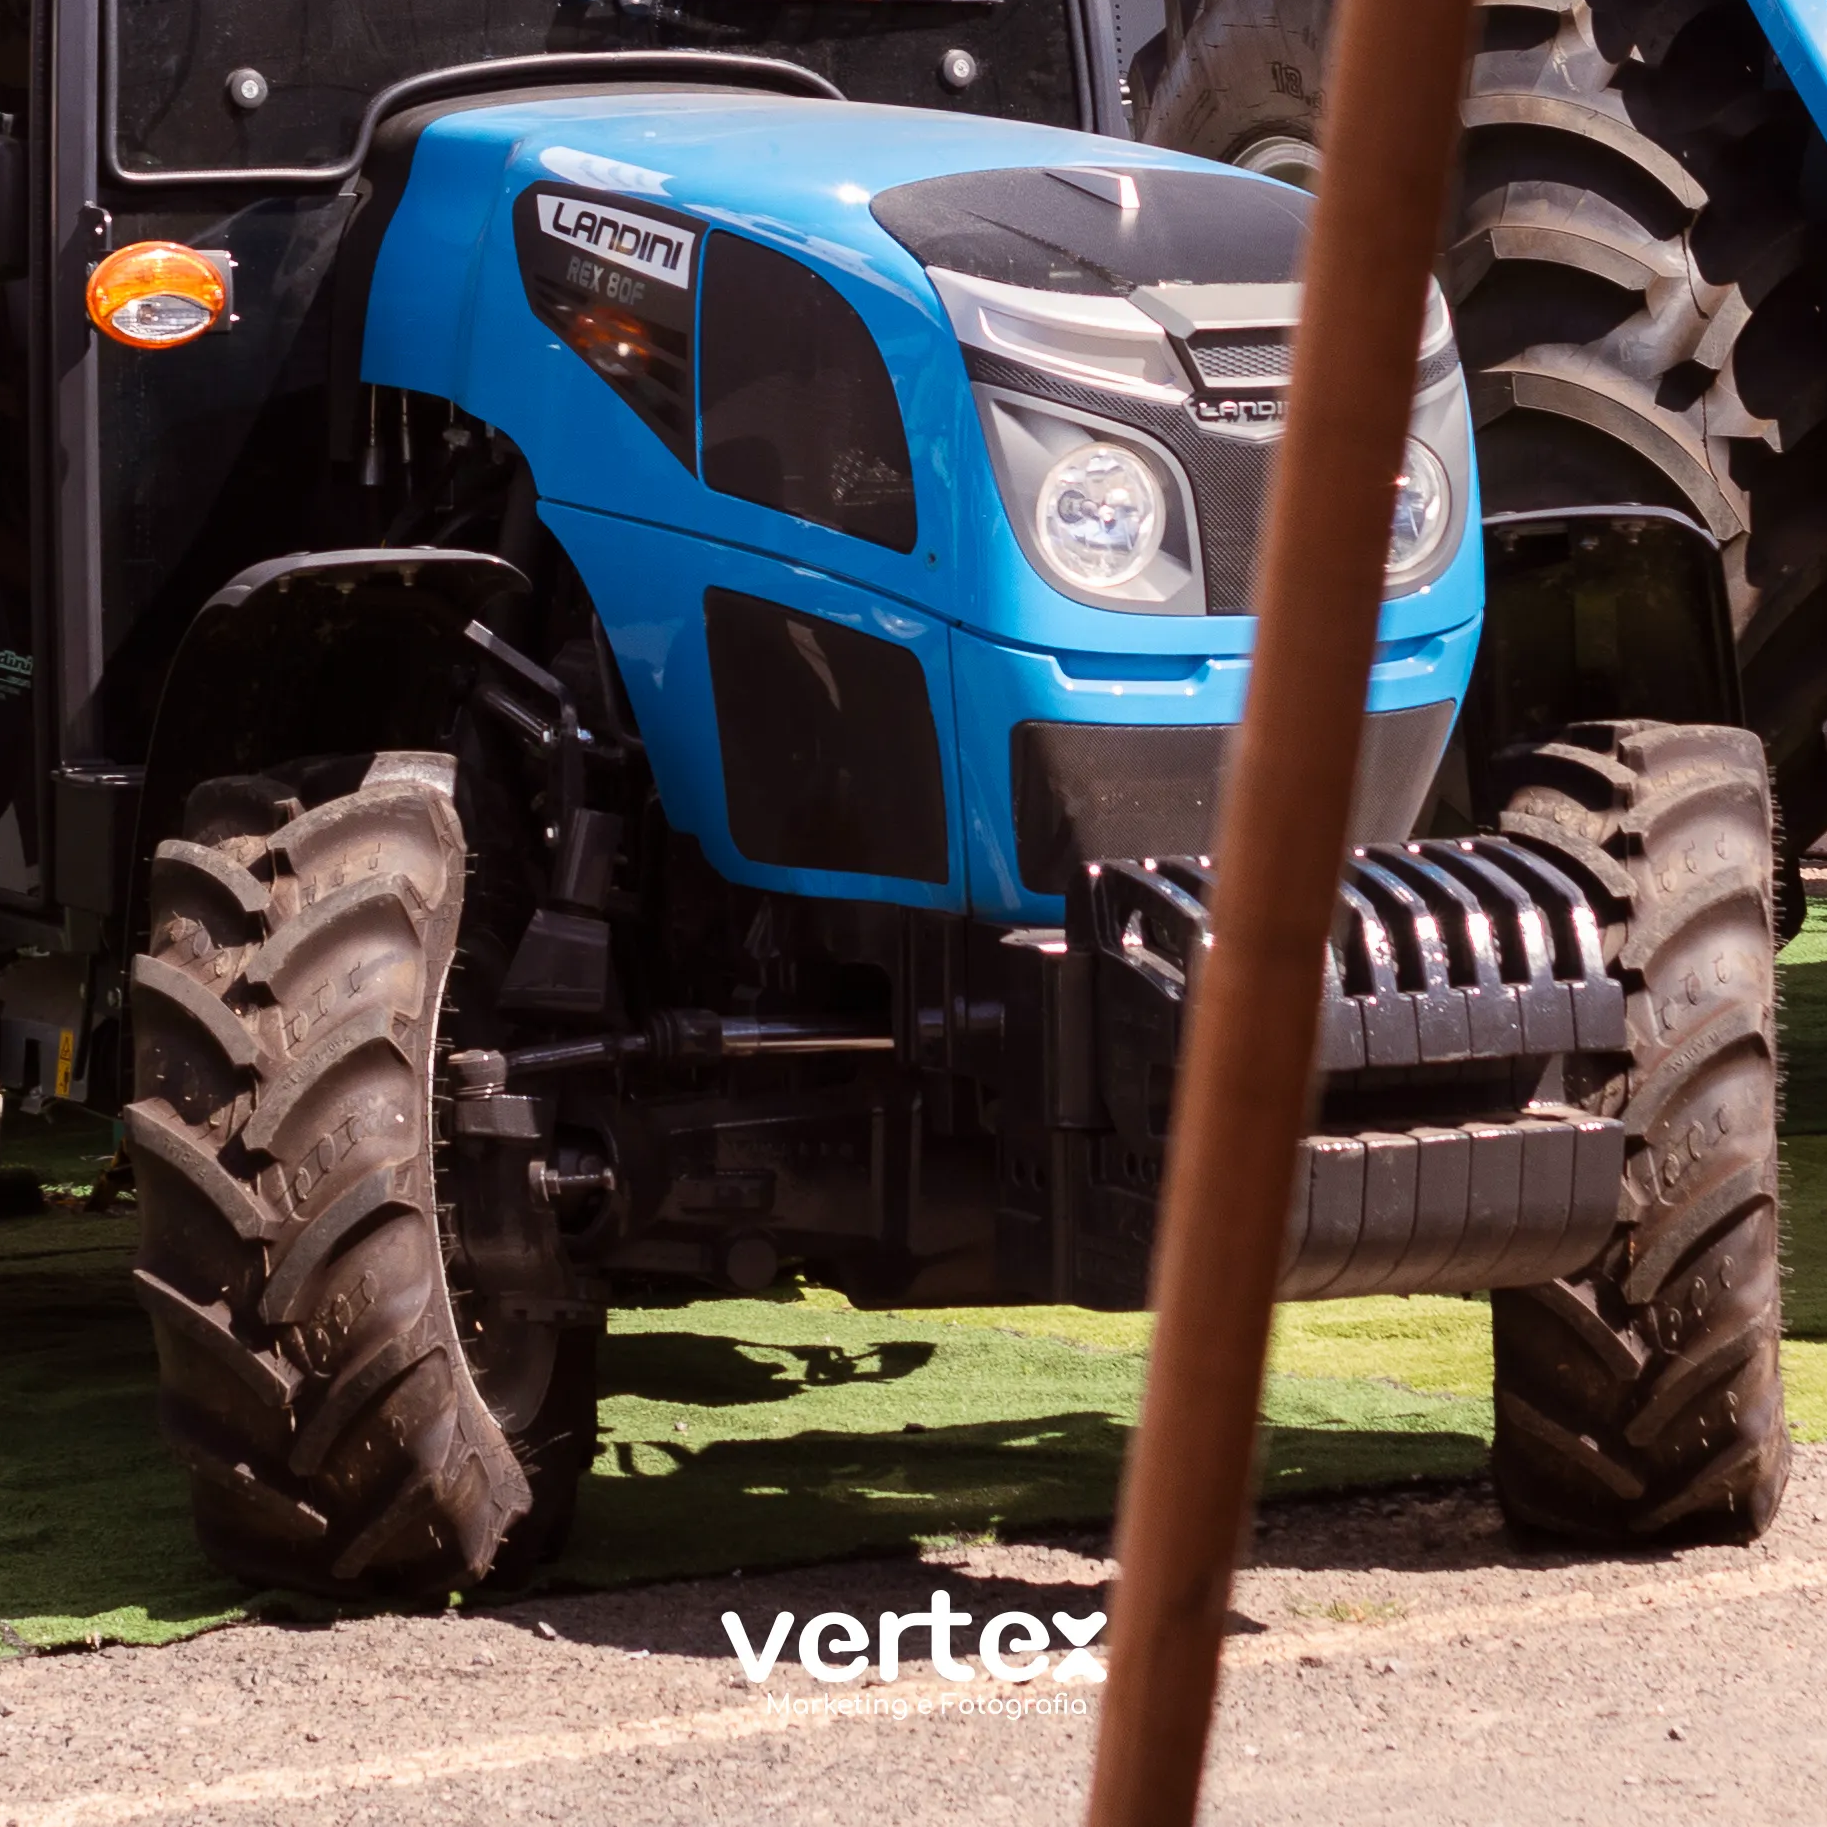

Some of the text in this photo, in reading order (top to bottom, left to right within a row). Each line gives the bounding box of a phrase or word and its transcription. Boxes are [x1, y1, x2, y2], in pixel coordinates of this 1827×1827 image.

[552, 201, 685, 271] LANDINI
[566, 255, 646, 306] REX 80F
